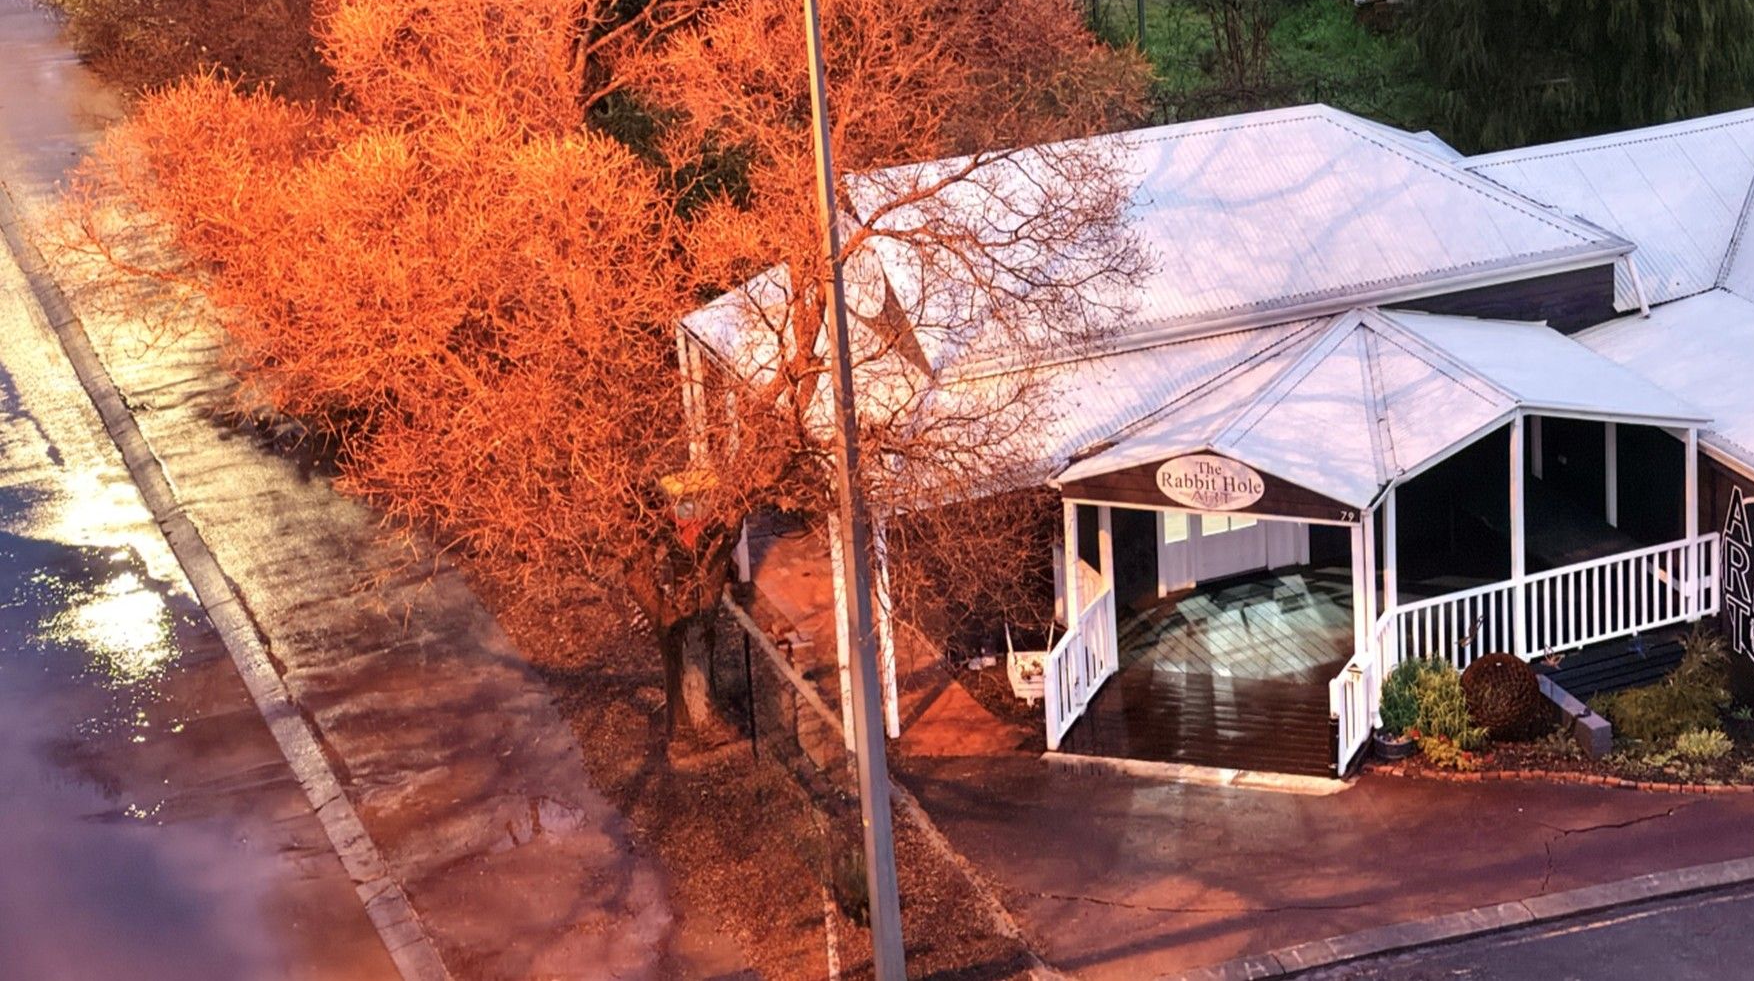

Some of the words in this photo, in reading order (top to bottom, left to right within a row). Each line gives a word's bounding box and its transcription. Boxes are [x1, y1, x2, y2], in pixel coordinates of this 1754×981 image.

[1195, 461, 1221, 475] The
[1161, 472, 1217, 491] Rabbit
[1223, 476, 1262, 494] Hole
[1340, 510, 1355, 522] 79
[1725, 485, 1752, 654] ART
